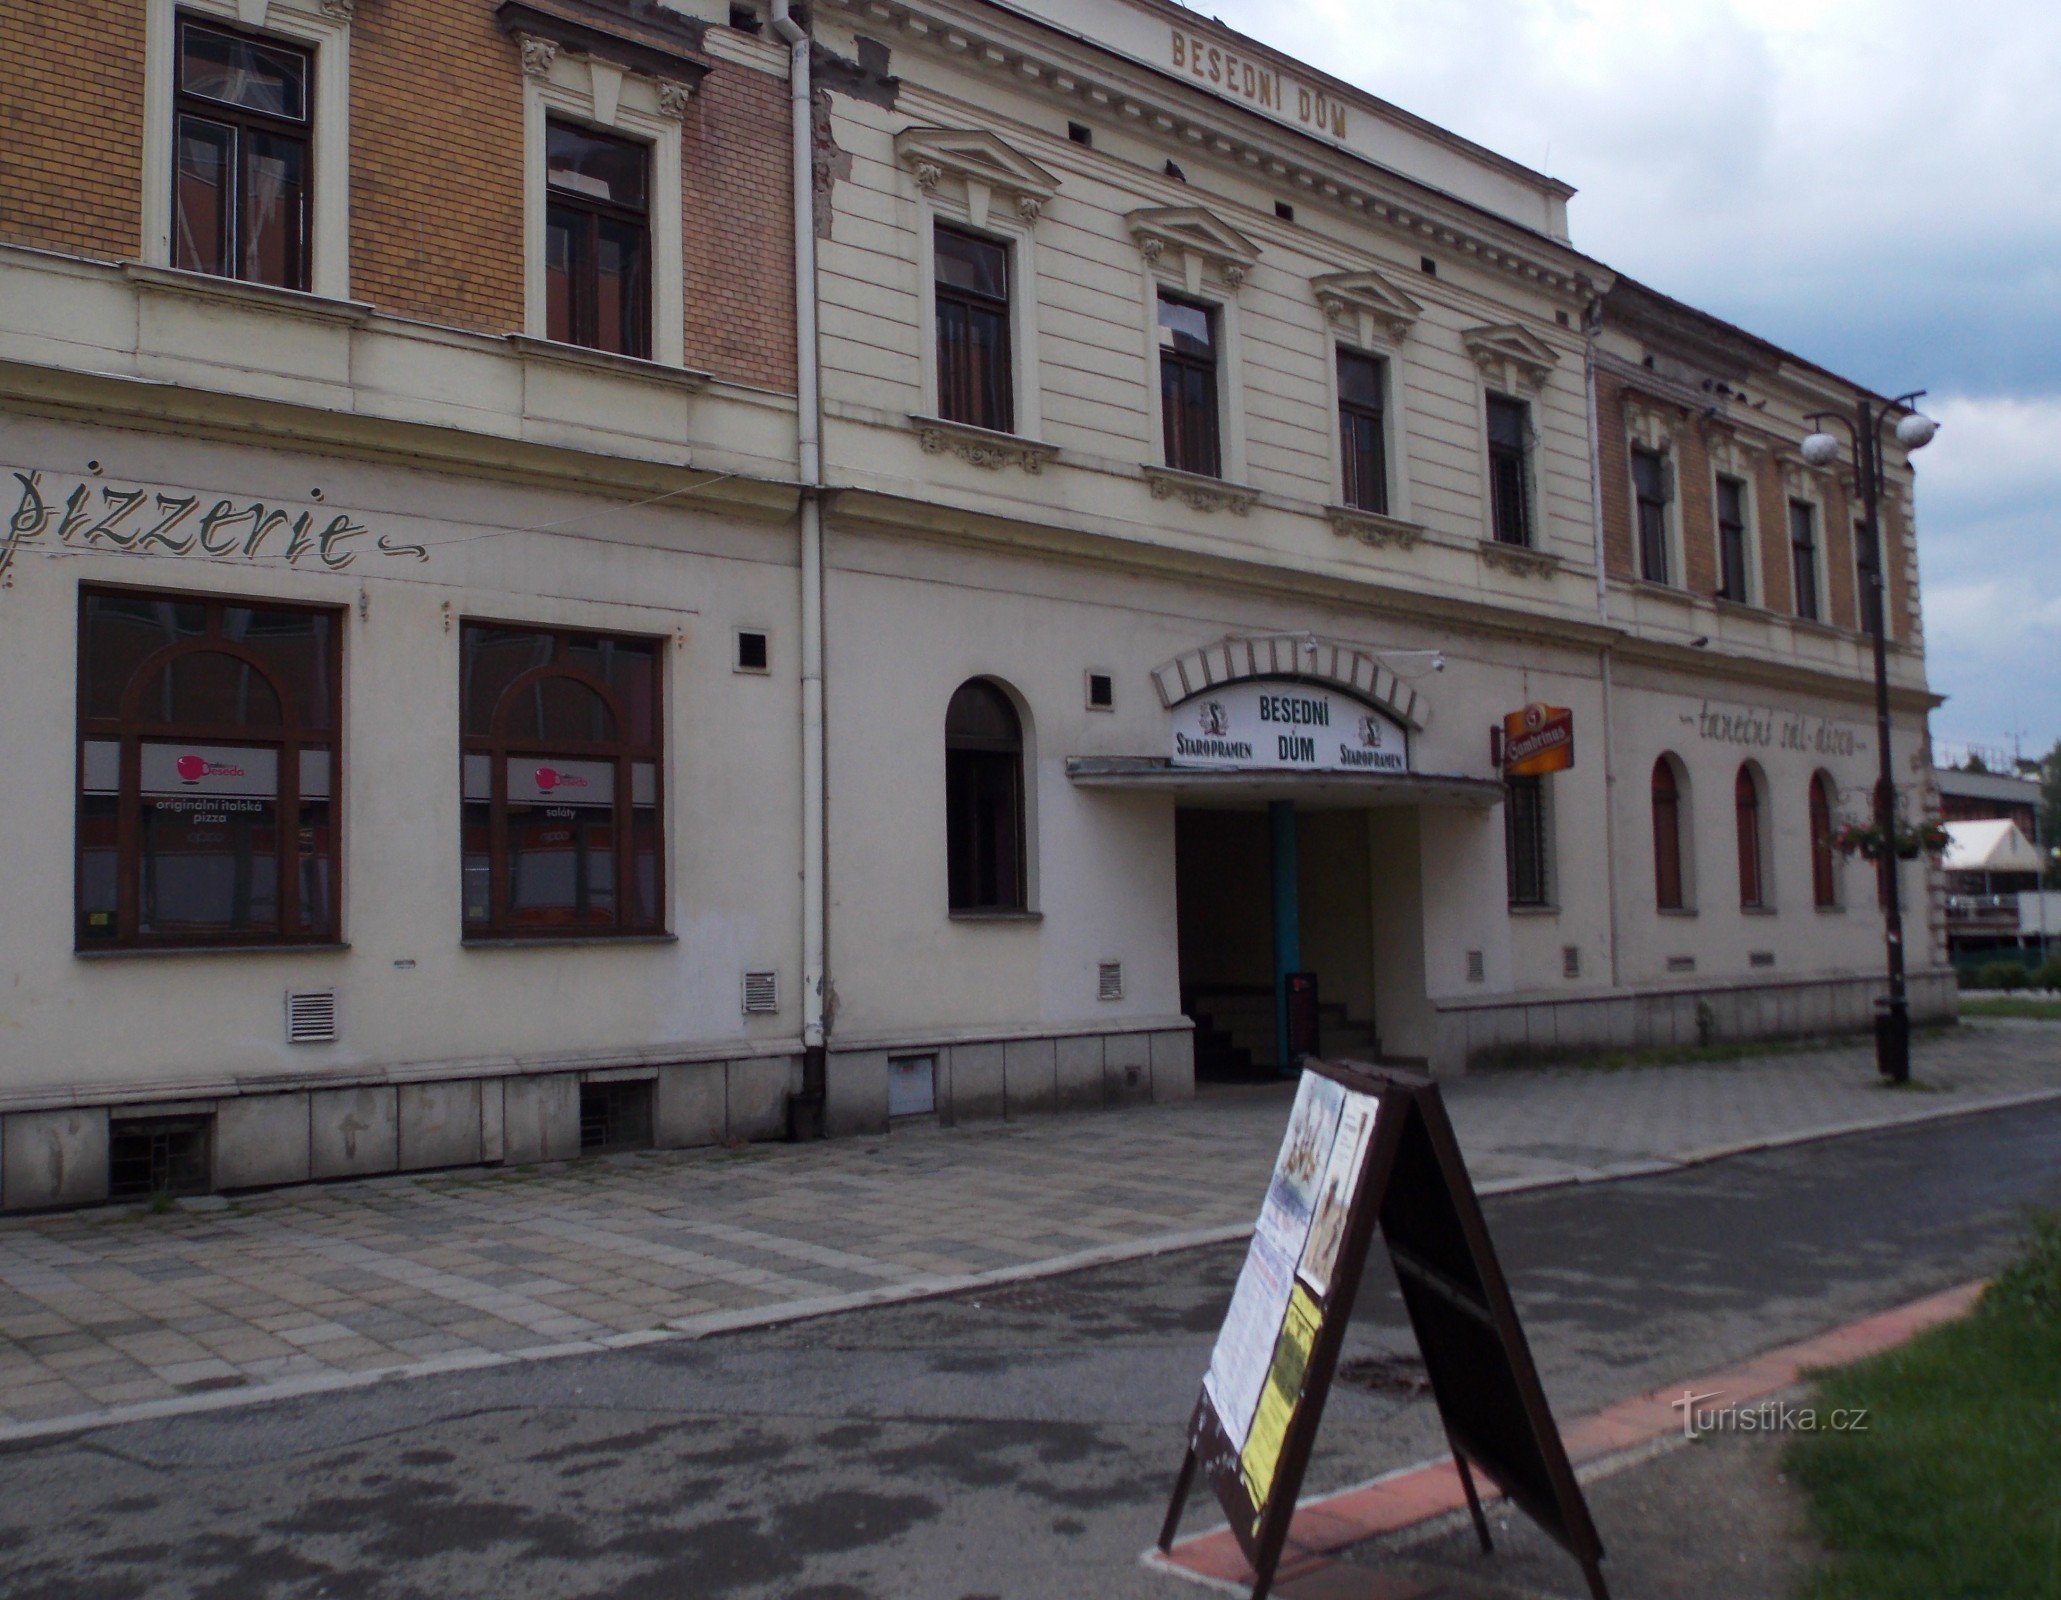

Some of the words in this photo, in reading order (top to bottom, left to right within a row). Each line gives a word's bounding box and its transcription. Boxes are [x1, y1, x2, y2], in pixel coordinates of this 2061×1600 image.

[0, 460, 367, 576] pizzerie
[1259, 695, 1330, 727] BESEDNÍ
[1278, 730, 1315, 763] DŮM
[156, 799, 219, 813] originální
[221, 800, 263, 813] italská
[193, 811, 227, 824] pizza
[546, 806, 577, 820] saláty
